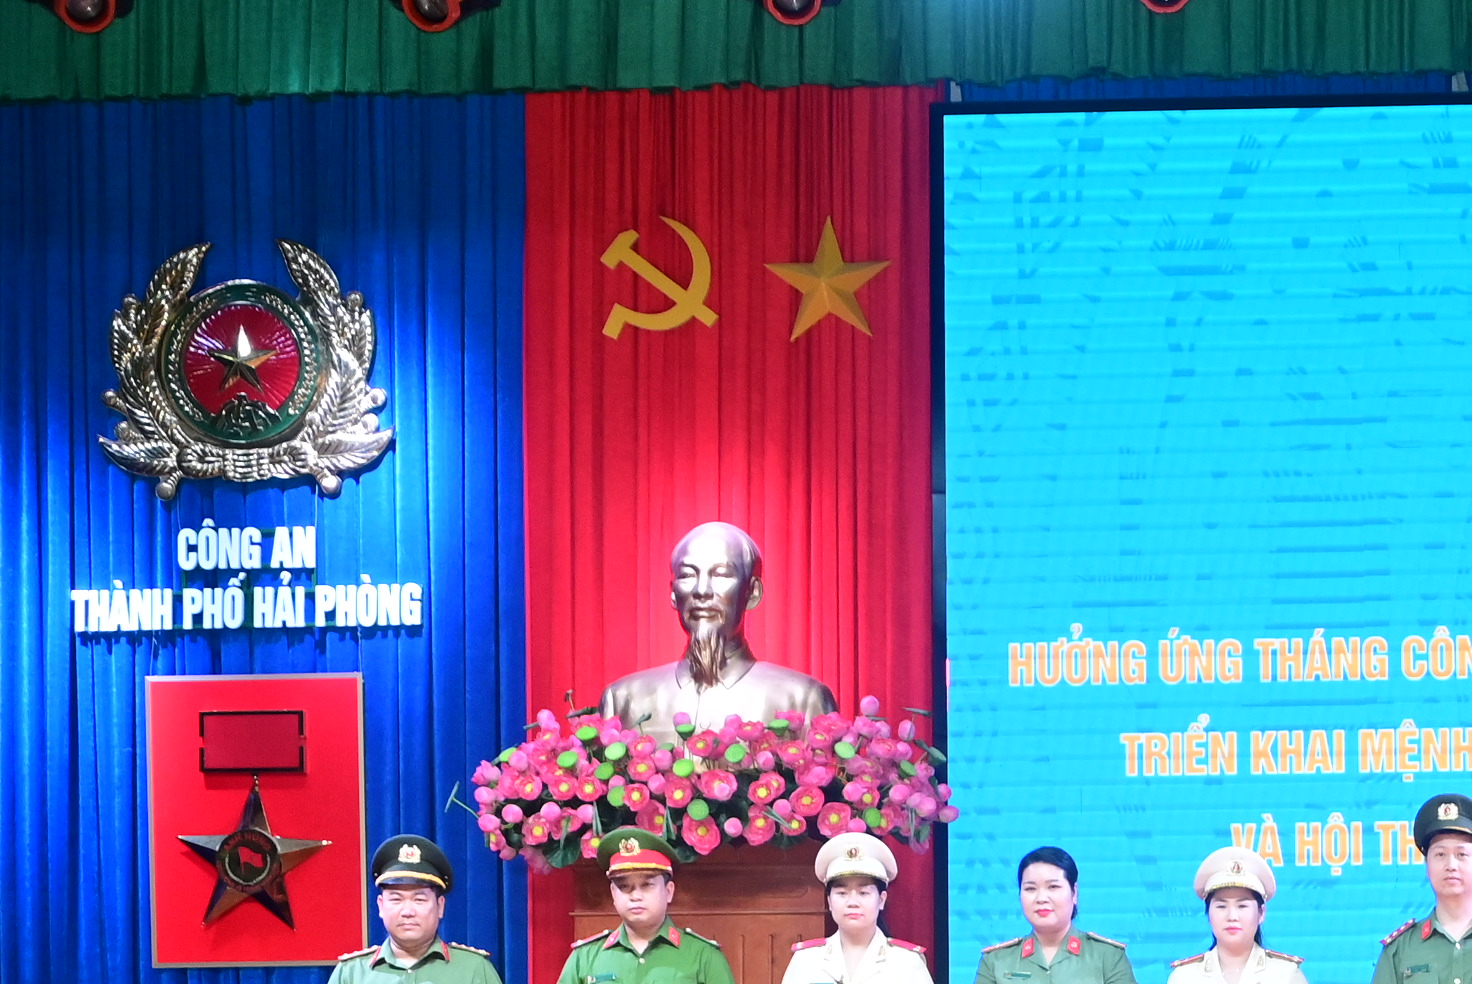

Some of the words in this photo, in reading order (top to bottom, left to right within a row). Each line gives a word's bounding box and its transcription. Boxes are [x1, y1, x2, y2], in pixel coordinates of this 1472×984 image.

[177, 518, 262, 570] CÔNG
[270, 526, 316, 568] AN
[71, 580, 173, 632] THÀNH
[182, 572, 247, 630] PHỐ
[253, 571, 306, 628] HẢI
[315, 574, 422, 627] PHÒNG
[1009, 623, 1147, 686] HƯỞNG
[1159, 628, 1243, 684] ỨNG
[1254, 628, 1389, 682] THÁNG
[1120, 714, 1237, 776] TRIỂN
[1251, 730, 1345, 774] KHAI
[1230, 813, 1284, 867] VÀ
[1296, 812, 1363, 876] HỘI
[1374, 821, 1425, 865] TH
